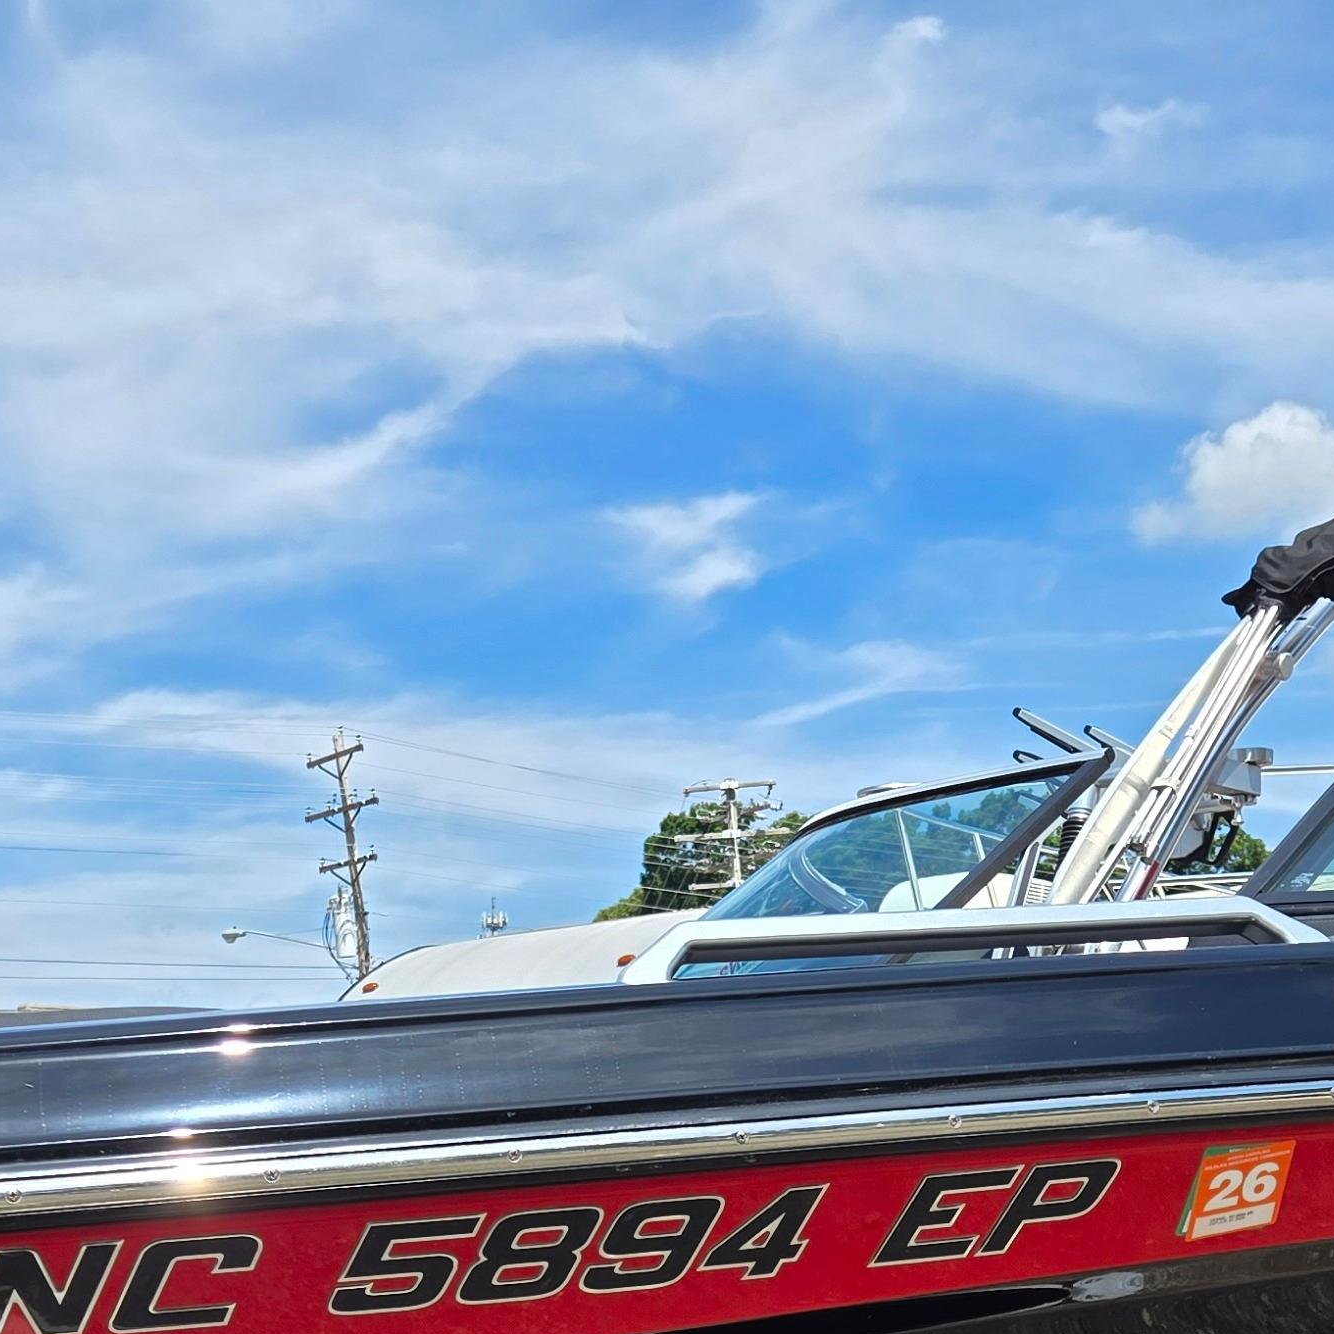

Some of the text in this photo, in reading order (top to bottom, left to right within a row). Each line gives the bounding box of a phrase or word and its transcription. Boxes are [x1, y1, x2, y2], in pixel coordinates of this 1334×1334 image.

[328, 1182, 830, 1315] 5894
[867, 1157, 1122, 1268] EP
[1203, 1161, 1280, 1212] 26
